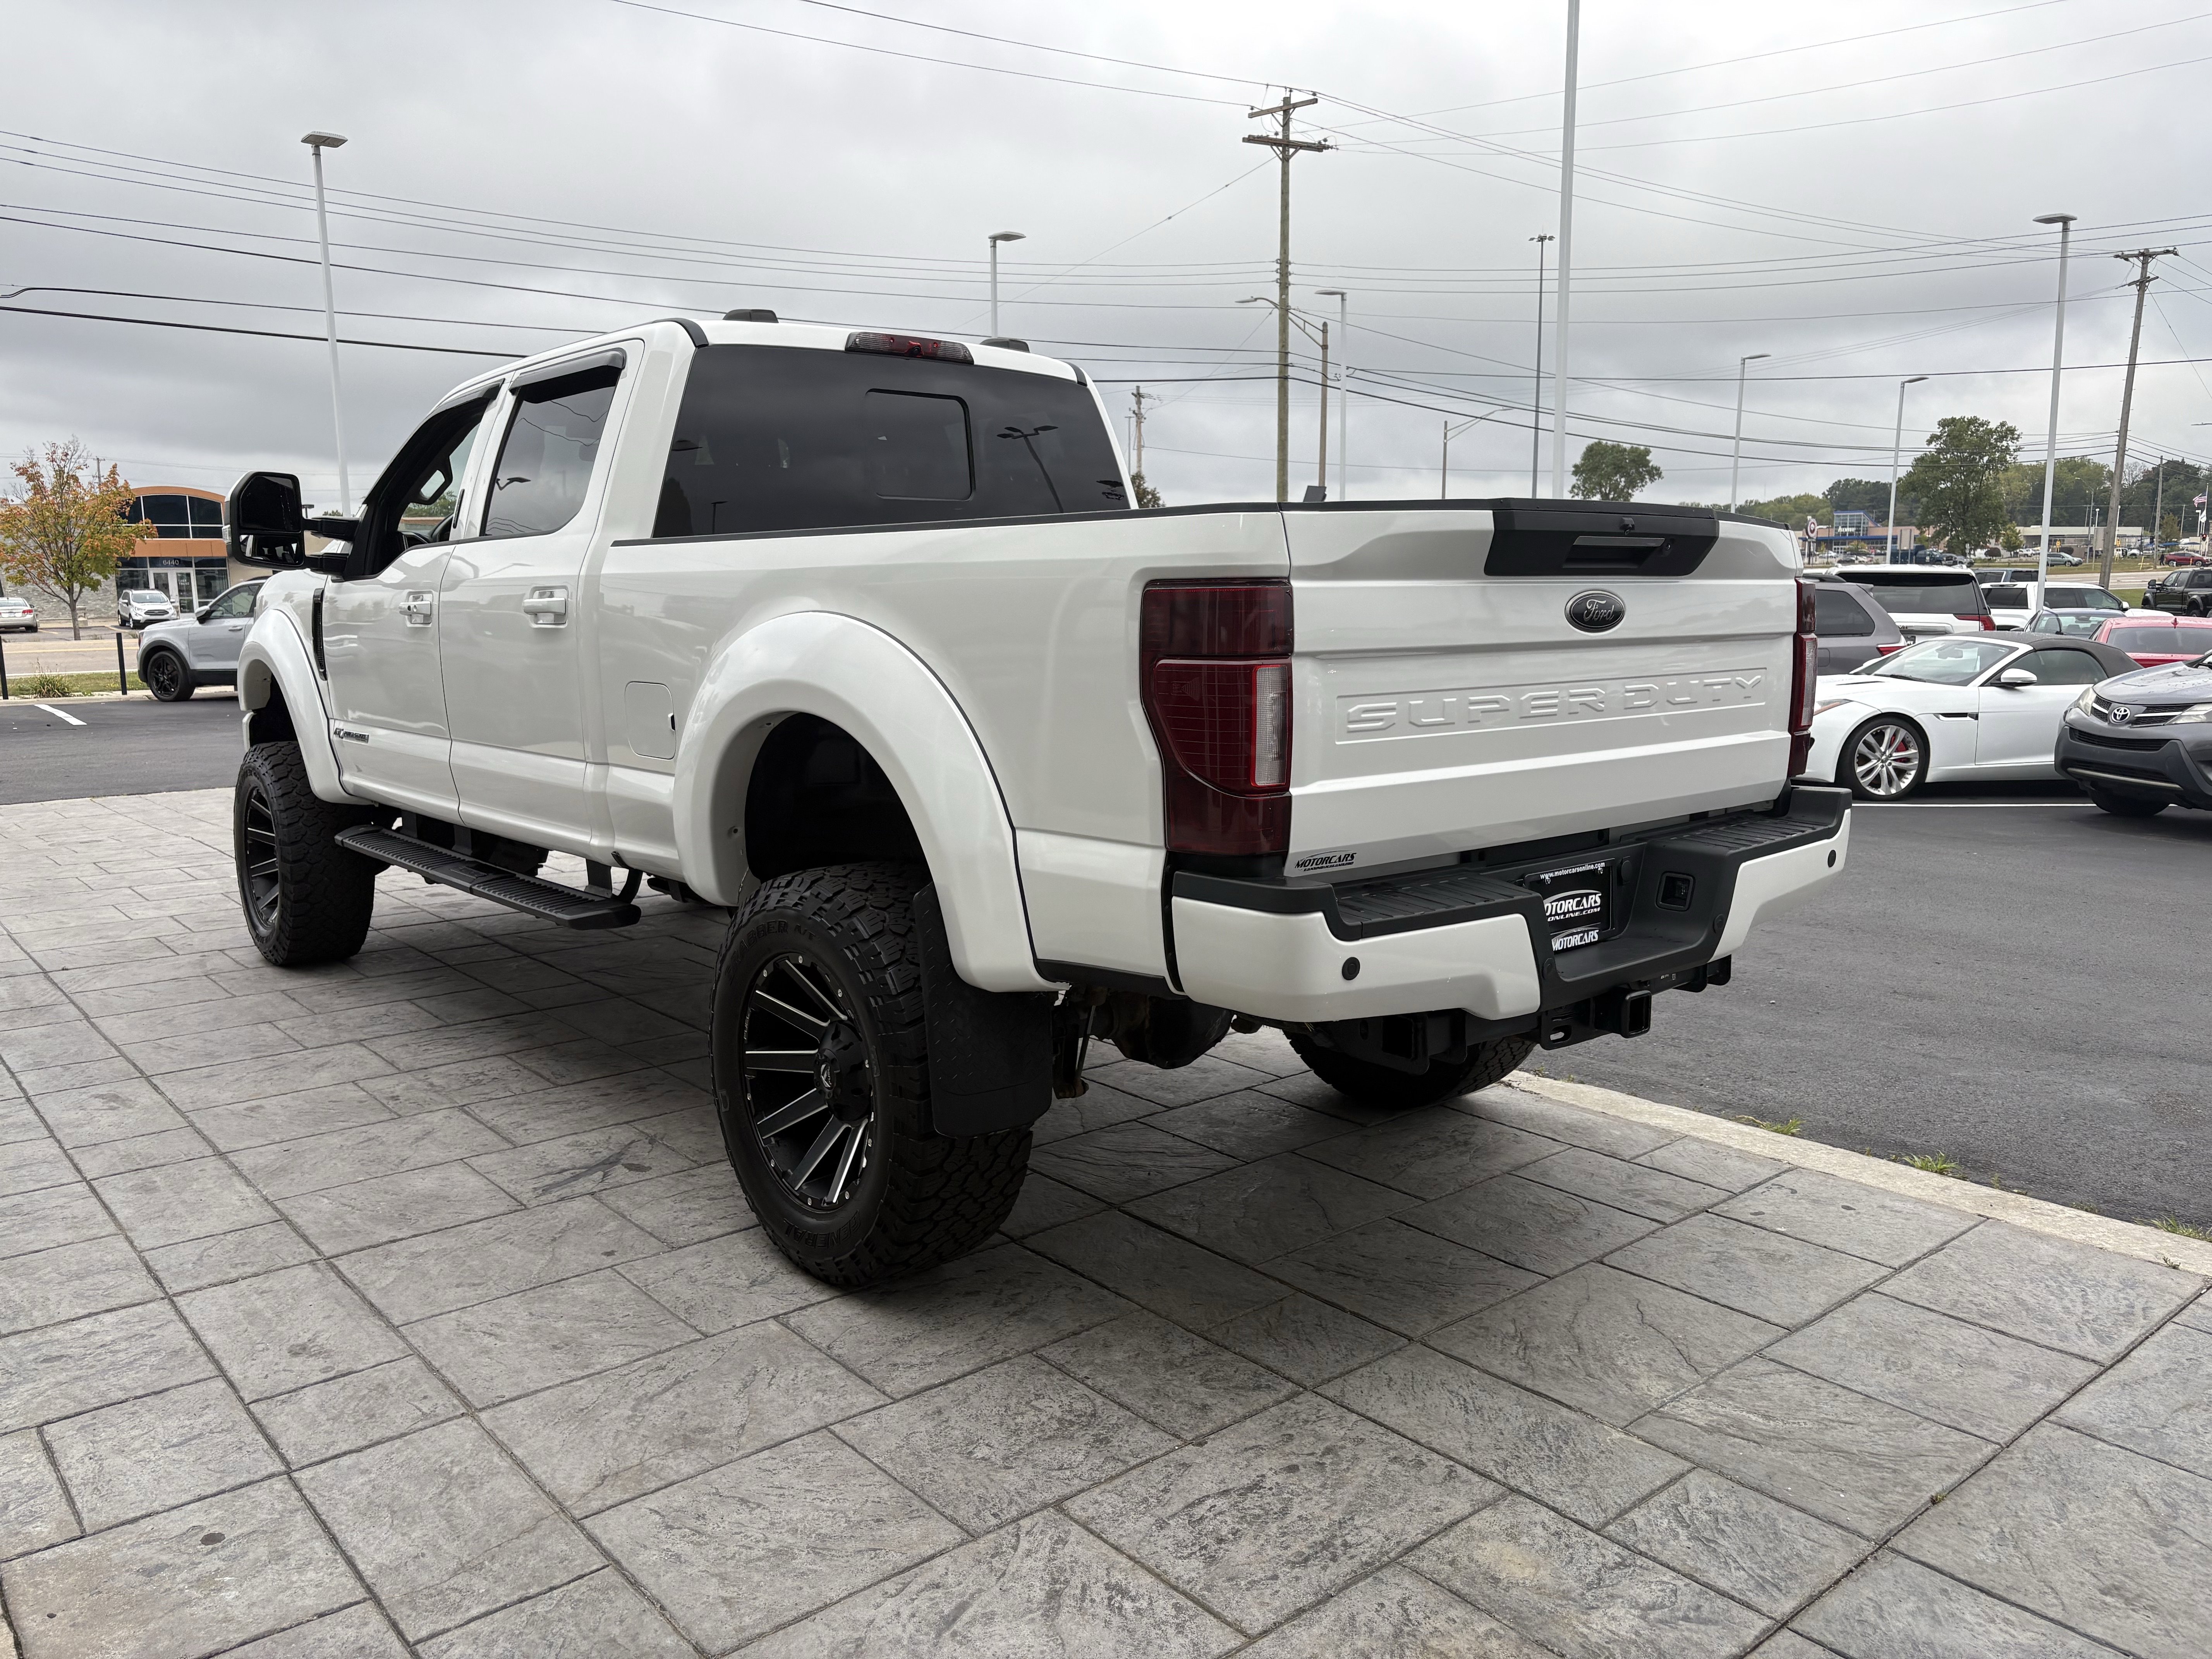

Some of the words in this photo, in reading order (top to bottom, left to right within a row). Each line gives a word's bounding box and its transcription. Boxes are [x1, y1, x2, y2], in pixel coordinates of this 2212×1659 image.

[1583, 599, 1614, 622] Ford
[1347, 687, 1605, 733] SUPER
[1624, 674, 1761, 710] DUTY
[1295, 852, 1357, 869] MOTORCARS
[1540, 862, 1605, 879] www.motorcarsonline.com
[1544, 893, 1602, 916] OTORCARS
[1547, 907, 1601, 922] ONLINE.COM
[1551, 929, 1599, 951] MOTORCARS
[783, 1209, 861, 1249] GENERAL
